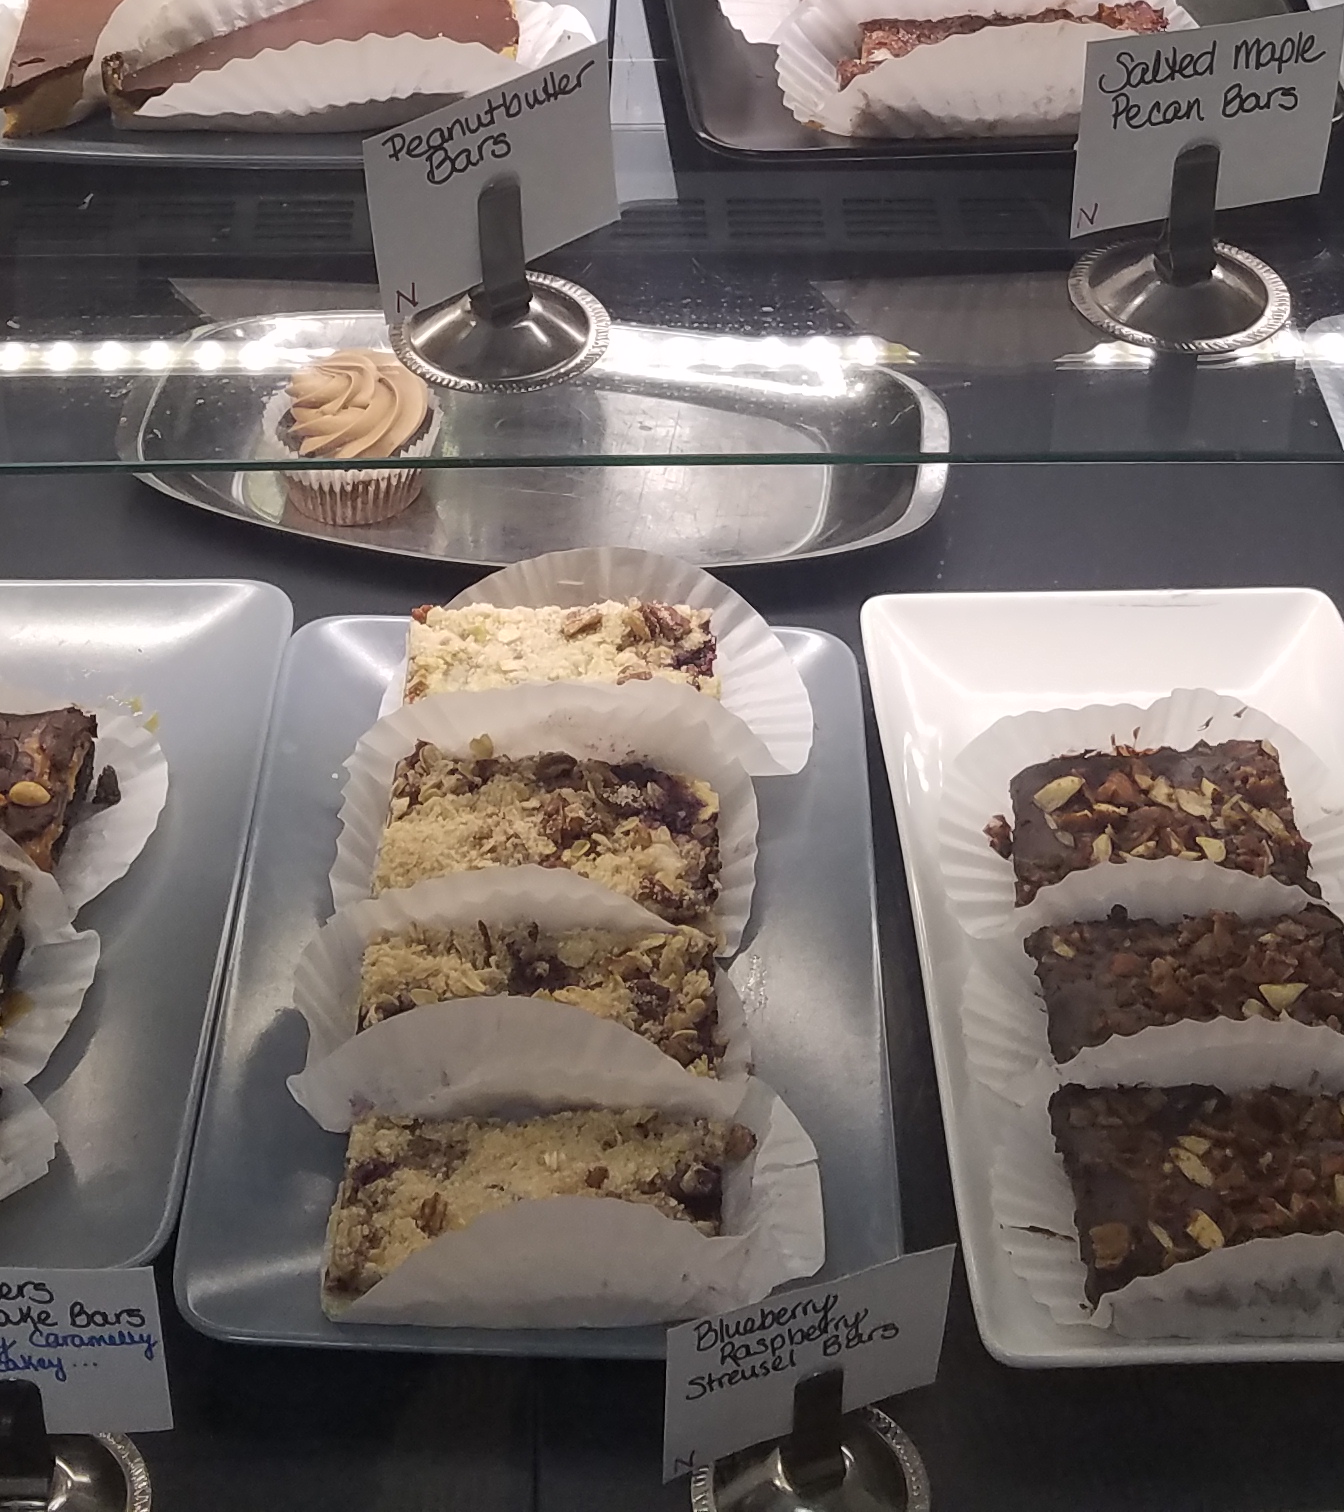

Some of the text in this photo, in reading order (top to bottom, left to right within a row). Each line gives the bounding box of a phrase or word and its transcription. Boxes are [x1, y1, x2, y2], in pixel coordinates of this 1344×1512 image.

[1098, 39, 1217, 94] Salted
[1111, 82, 1299, 130] Pecan Bars
[425, 132, 512, 185] Bars
[1076, 202, 1099, 229] N
[396, 282, 419, 314] N
[69, 1301, 146, 1329] Bars
[693, 1293, 839, 1353] Blueberry
[719, 1307, 869, 1368] Raspberry
[685, 1322, 900, 1401] Streusel Bars
[674, 1449, 695, 1475] N
